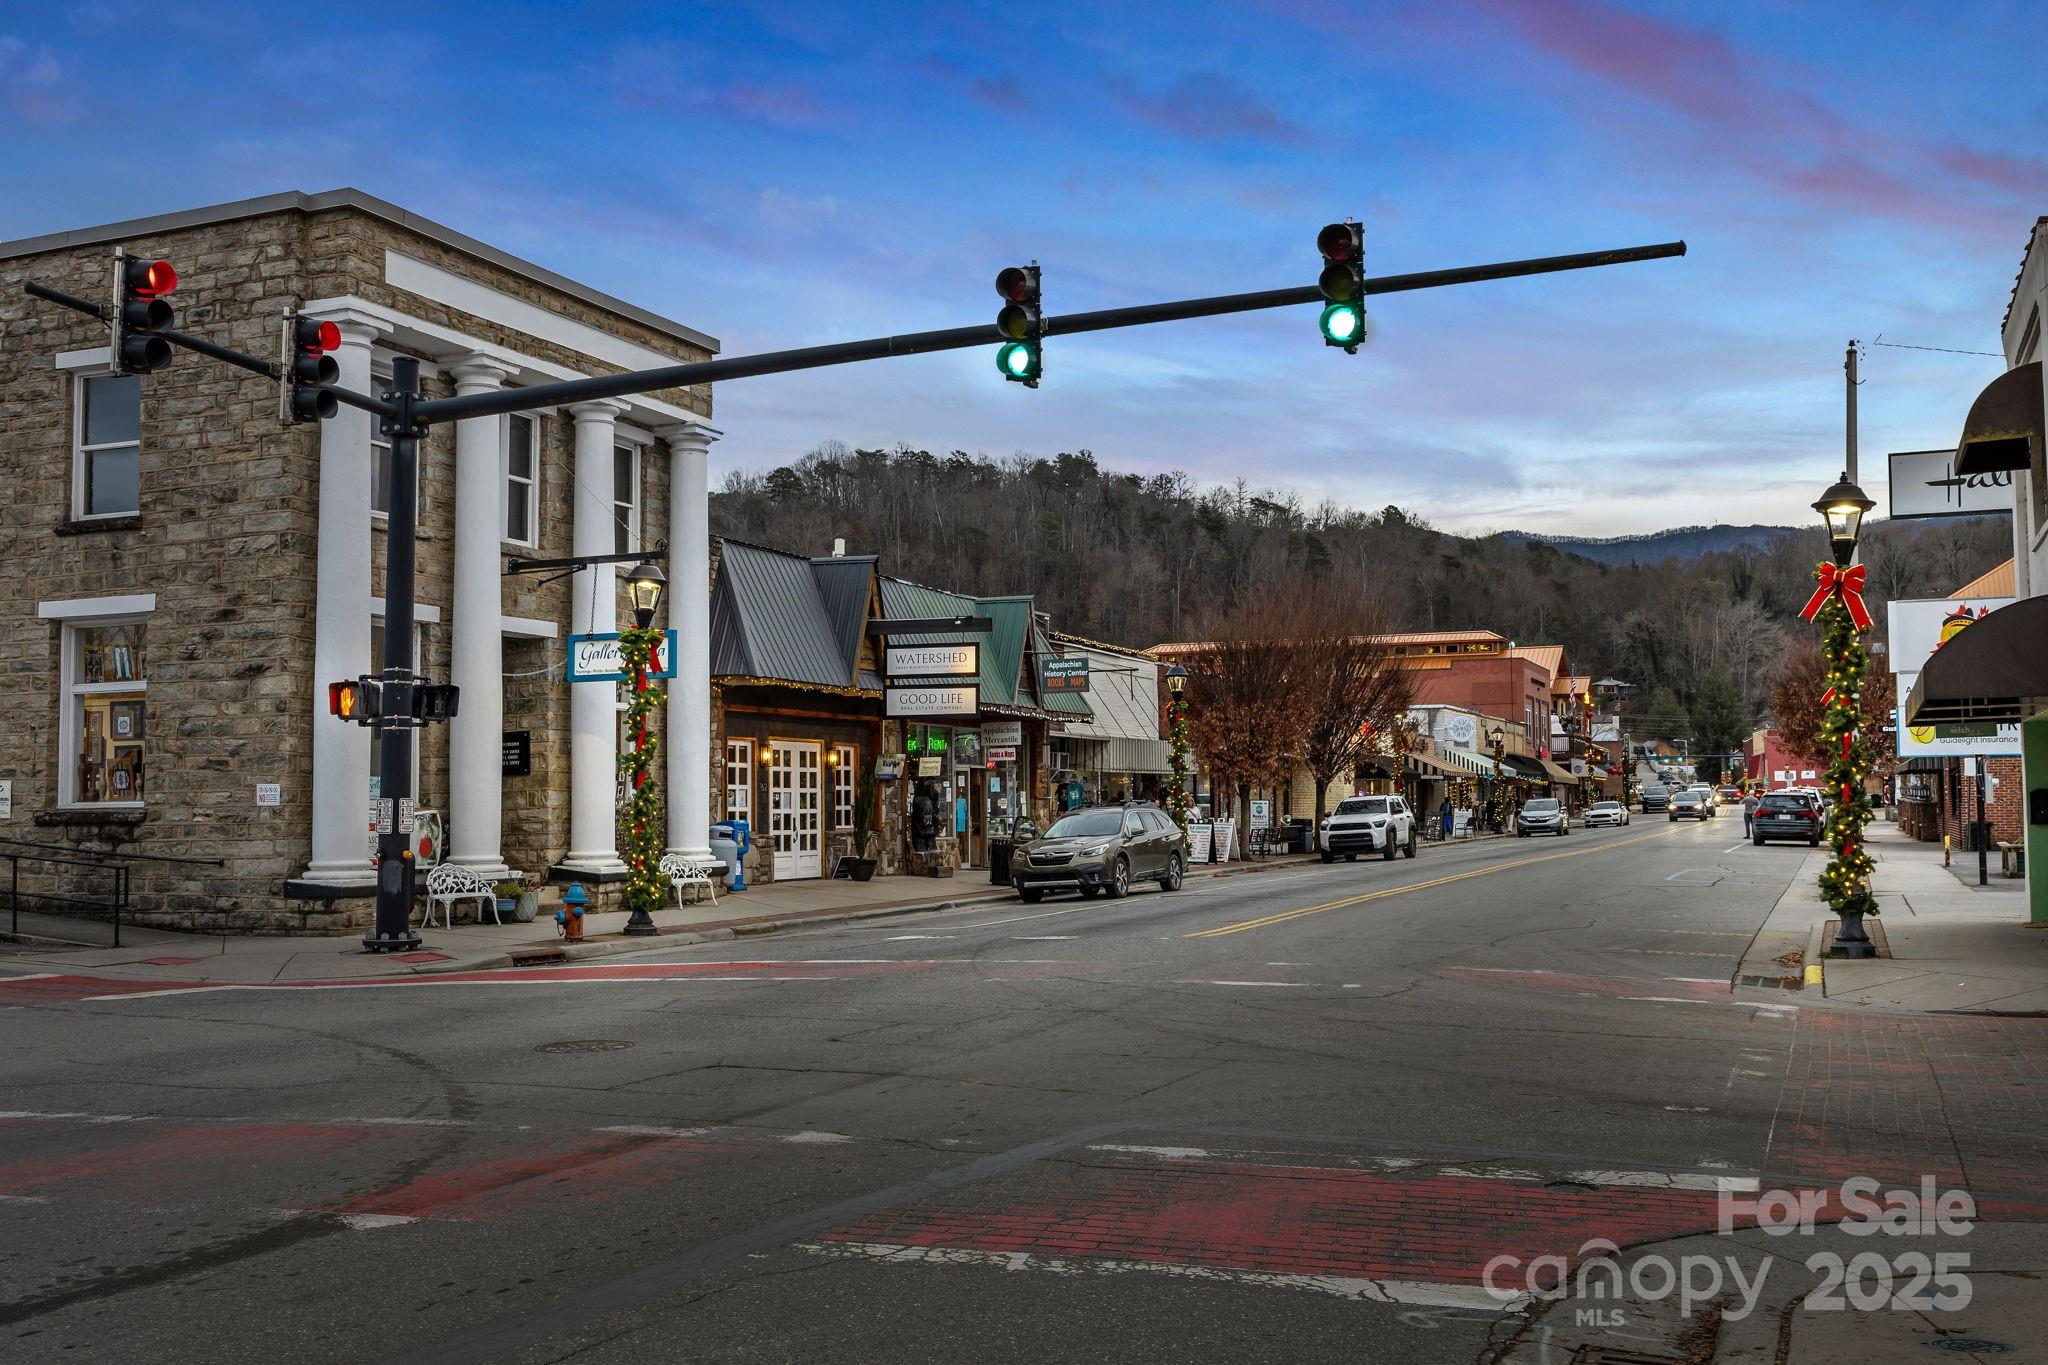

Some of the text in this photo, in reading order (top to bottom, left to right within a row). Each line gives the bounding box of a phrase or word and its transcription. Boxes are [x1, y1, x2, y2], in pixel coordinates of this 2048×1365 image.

[895, 652, 968, 664] WATERSHED
[1048, 661, 1082, 669] Appalachian
[1047, 677, 1085, 687] BOOKS MAPS
[900, 693, 963, 704] GOOD LIFE
[984, 726, 1019, 735] Appalachian
[1939, 736, 2018, 746] Guidelight Insurance
